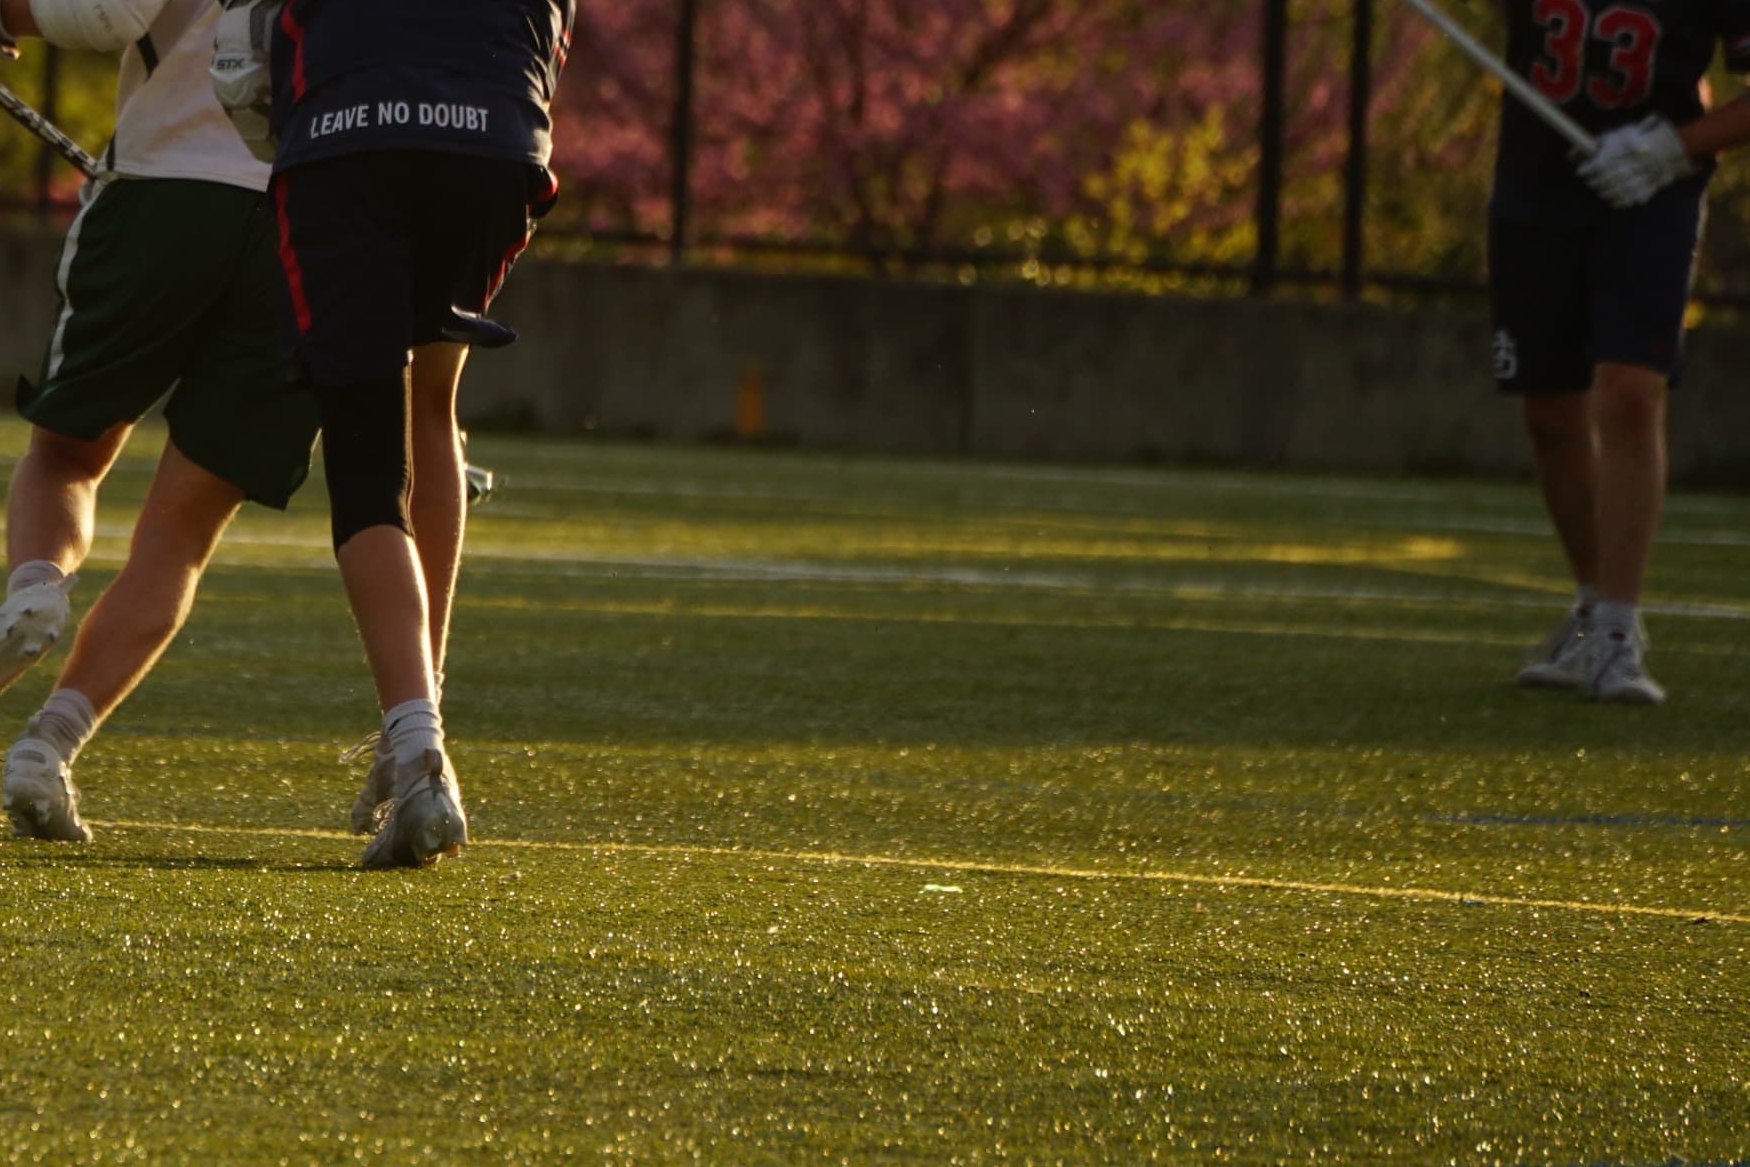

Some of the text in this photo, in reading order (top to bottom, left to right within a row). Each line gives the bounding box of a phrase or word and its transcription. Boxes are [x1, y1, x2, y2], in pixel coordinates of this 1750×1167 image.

[217, 57, 245, 71] STX
[310, 102, 488, 139] LEAVE NO DOUBT
